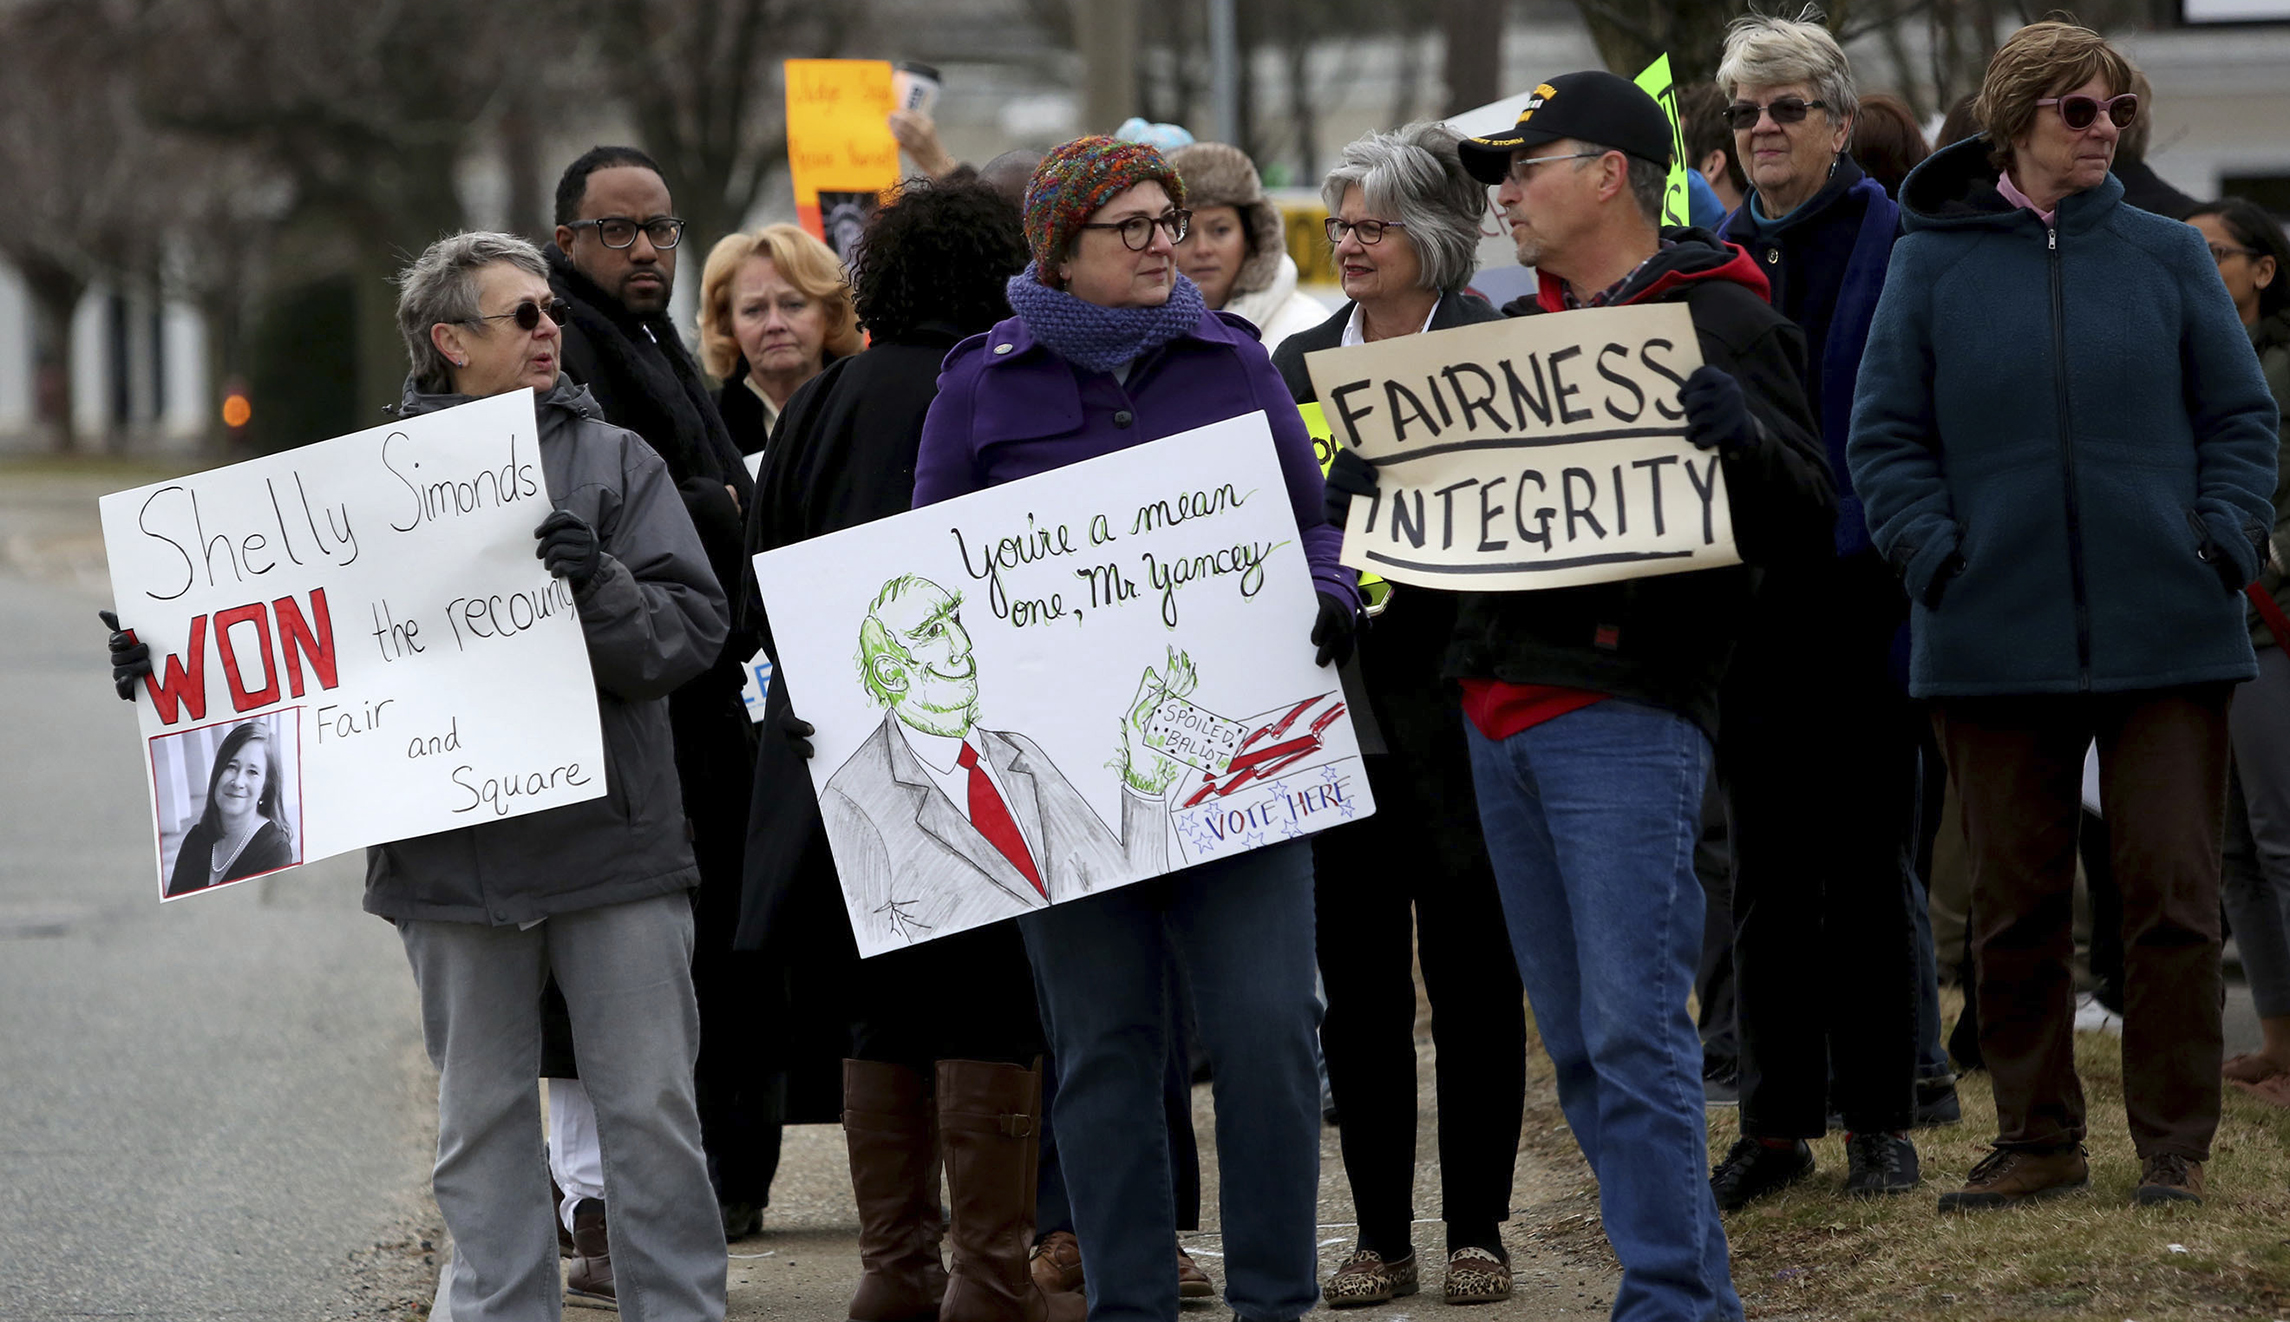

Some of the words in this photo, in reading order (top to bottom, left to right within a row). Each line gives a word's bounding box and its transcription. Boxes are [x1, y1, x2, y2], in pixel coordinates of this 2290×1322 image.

[1492, 137, 1525, 146] STORM
[1331, 338, 1689, 448] FAIRNESS
[138, 471, 358, 600] Shelly
[381, 431, 537, 532] Simonds
[1365, 455, 1720, 553] INTEGRITY
[951, 512, 1077, 619] You're
[1089, 514, 1116, 547] a
[1128, 484, 1254, 534] mean
[1011, 593, 1083, 628] one,
[1073, 563, 1141, 608] Mr.
[1142, 541, 1285, 631] Yancey
[121, 587, 339, 726] WON
[372, 602, 426, 663] the
[317, 699, 394, 744] Fair
[408, 716, 461, 759] and
[1164, 704, 1235, 743] SPOILED
[1166, 730, 1229, 764] BALLOT
[452, 762, 591, 815] Square
[1205, 800, 1278, 841] VOTE
[1287, 775, 1355, 820] HERE
